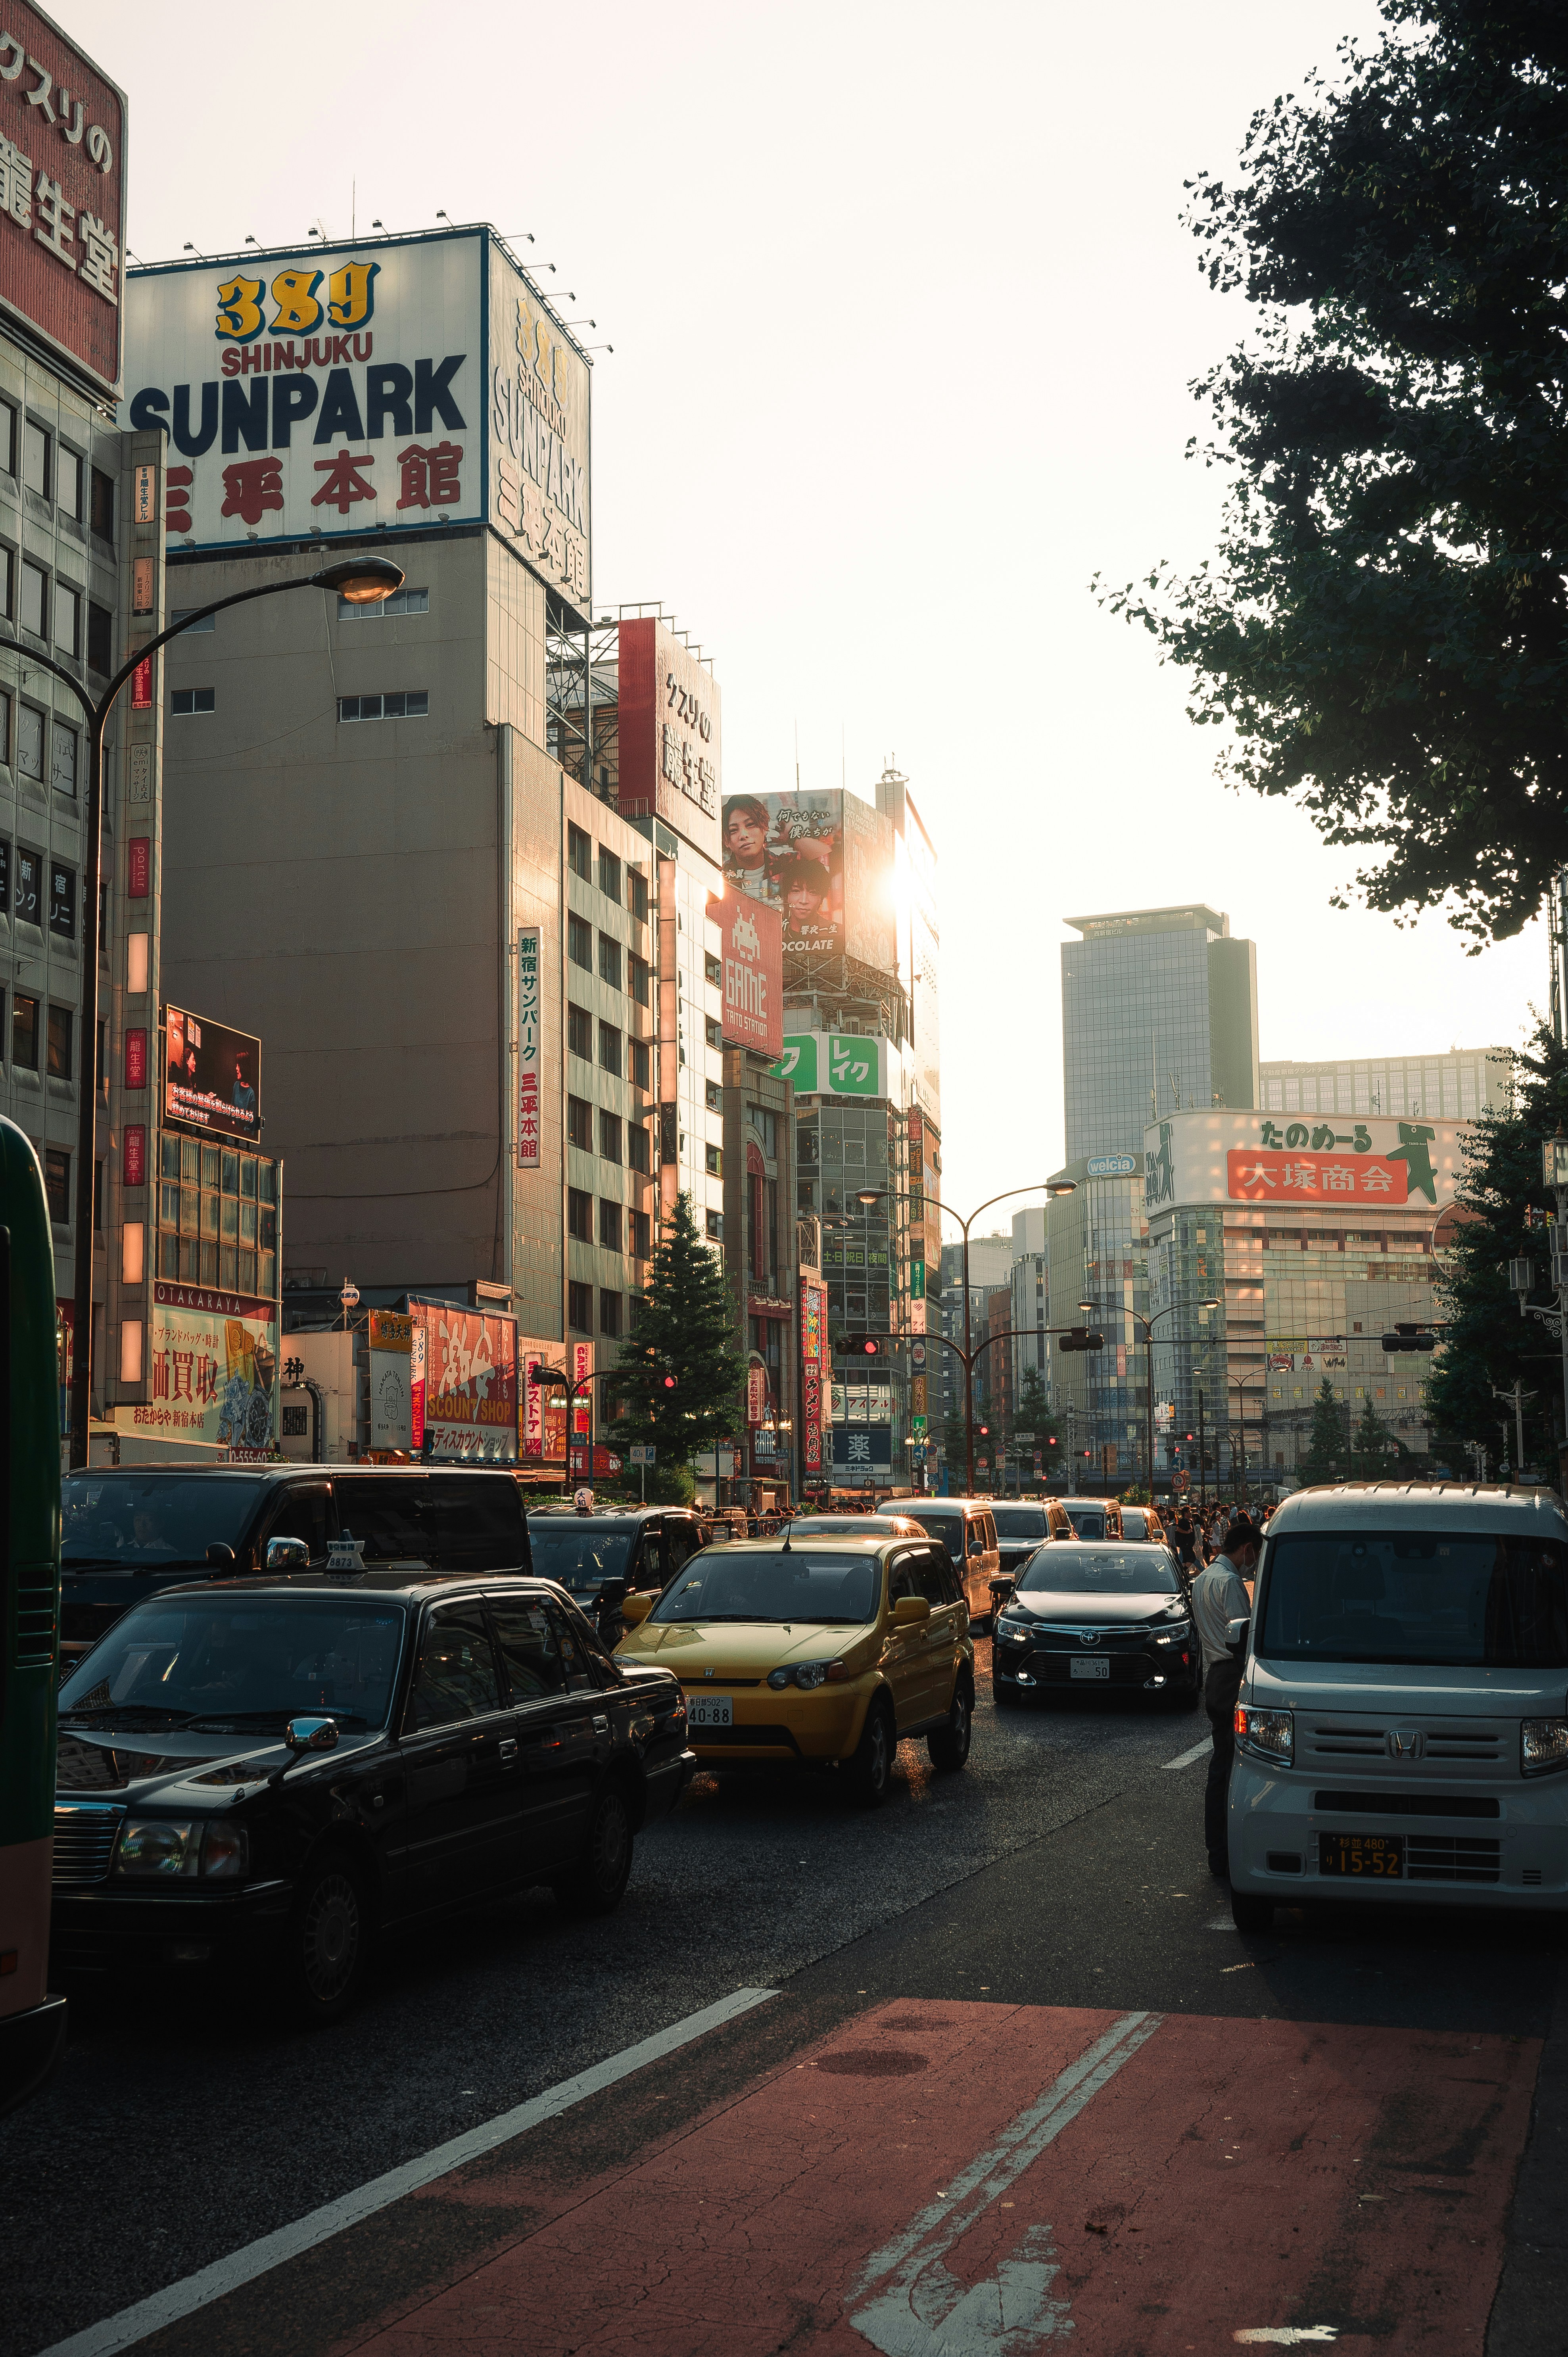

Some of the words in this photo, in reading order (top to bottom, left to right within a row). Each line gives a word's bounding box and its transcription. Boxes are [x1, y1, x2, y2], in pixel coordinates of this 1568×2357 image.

[216, 261, 380, 345] 389
[221, 331, 373, 377] SHINJUKU
[129, 354, 468, 458] SUNPARK
[518, 363, 567, 443] SHINJUKU
[494, 366, 587, 539] SUNPARK
[777, 809, 830, 822] 何でもない
[789, 826, 833, 839] 僕たちが
[521, 937, 538, 1062] 新宿サンパーク
[725, 957, 767, 1019] GAME
[726, 1008, 743, 1028] TAITO
[744, 1015, 767, 1038] STATION
[129, 1040, 141, 1077] 龍生堂
[520, 1072, 538, 1159] 三平本館
[1260, 1121, 1372, 1152] たのめーる
[128, 1136, 140, 1171] 龍生堂
[1090, 1158, 1130, 1172] welcia
[1243, 1162, 1393, 1192] 大塚商会
[823, 1251, 843, 1263] 土・日
[846, 1251, 864, 1263] 祝日
[868, 1253, 887, 1265] 夜間
[158, 1285, 241, 1314] OTAKARAYA
[381, 1320, 411, 1343] 博多天神
[914, 1348, 925, 1359] 薬
[282, 1357, 305, 1382] 神
[379, 1370, 392, 1395] HAKATA
[392, 1370, 405, 1398] TENJIN
[806, 1377, 819, 1418] ラーメン
[915, 1378, 924, 1414] 肉汁水餃子
[481, 1399, 511, 1422] SHOP
[848, 1399, 889, 1408] アイフル
[134, 1406, 171, 1427] おたからや
[172, 1409, 205, 1429] 新宿本店
[755, 1430, 776, 1454] GAME
[848, 1434, 871, 1461] 薬
[576, 1491, 586, 1506] 大和
[330, 1557, 352, 1567] 8873
[1095, 1667, 1107, 1677] 50
[689, 1707, 729, 1723] 40-88
[1339, 1837, 1362, 1849] 杉並
[1364, 1838, 1385, 1850] 480
[1341, 1850, 1398, 1875] 15-52
